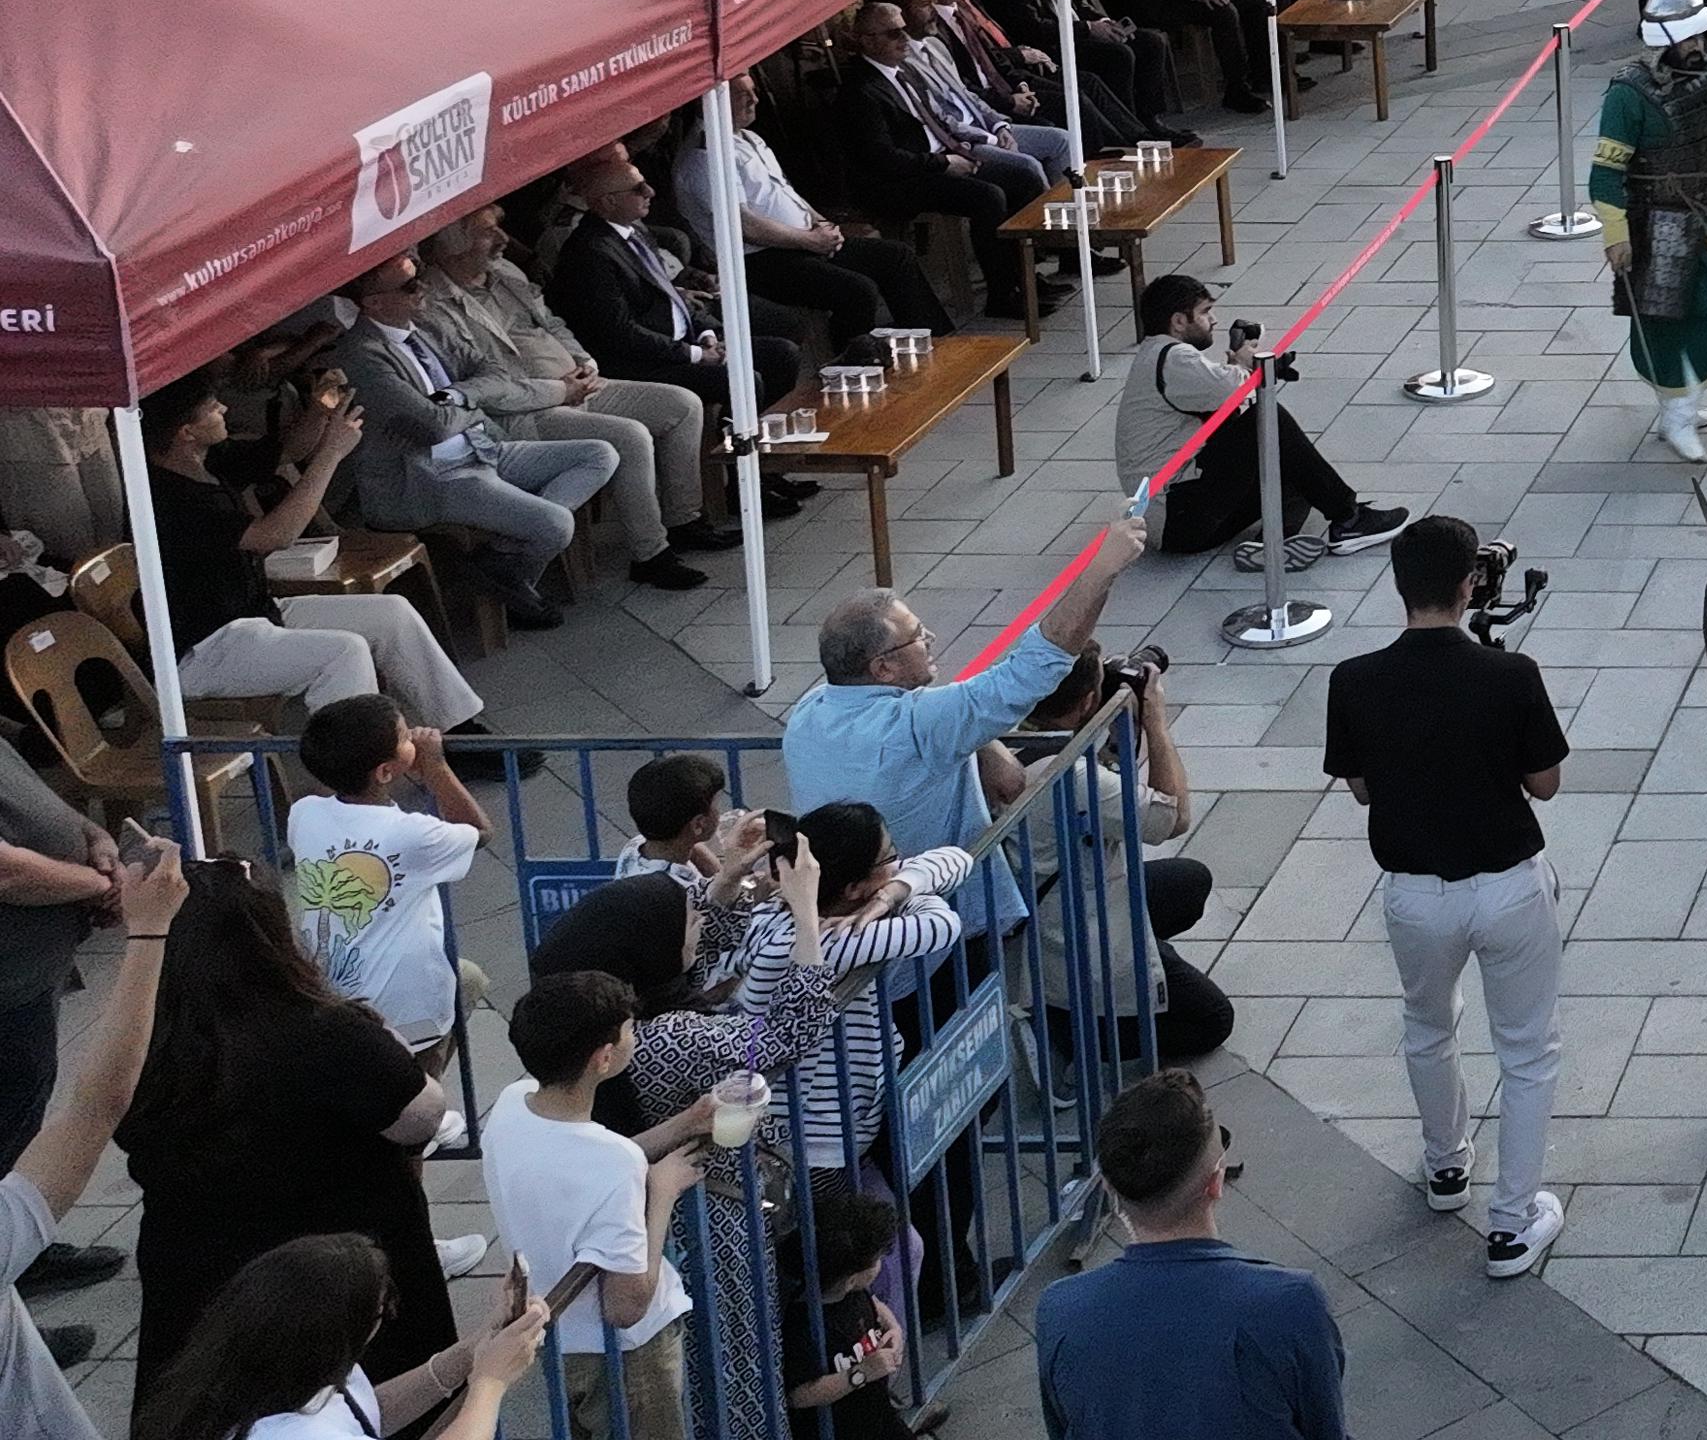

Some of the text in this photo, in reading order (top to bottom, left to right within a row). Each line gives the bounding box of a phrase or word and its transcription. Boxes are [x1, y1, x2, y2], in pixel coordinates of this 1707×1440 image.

[502, 19, 693, 126] KÜLTÜR SANAT ETKİNLİKLERİ
[408, 126, 476, 192] SANAT
